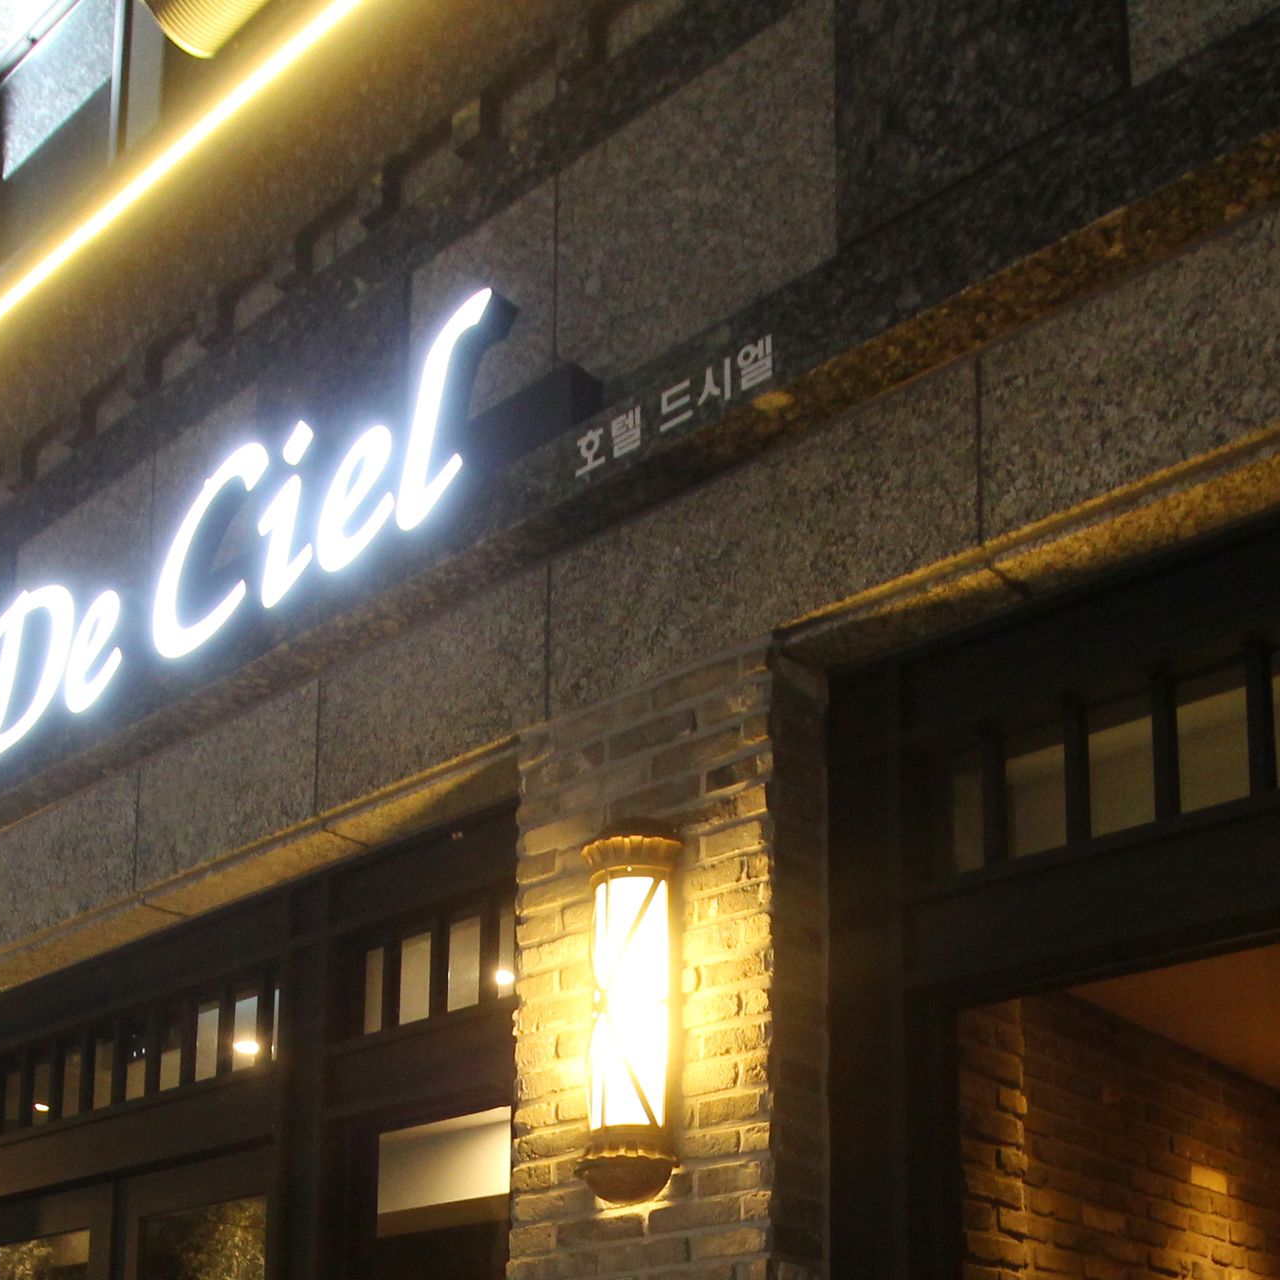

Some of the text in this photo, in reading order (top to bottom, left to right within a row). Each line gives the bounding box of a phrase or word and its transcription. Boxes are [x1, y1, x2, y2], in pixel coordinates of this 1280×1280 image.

[148, 286, 494, 662] Ciel
[574, 333, 773, 479] 호텔 드시엘
